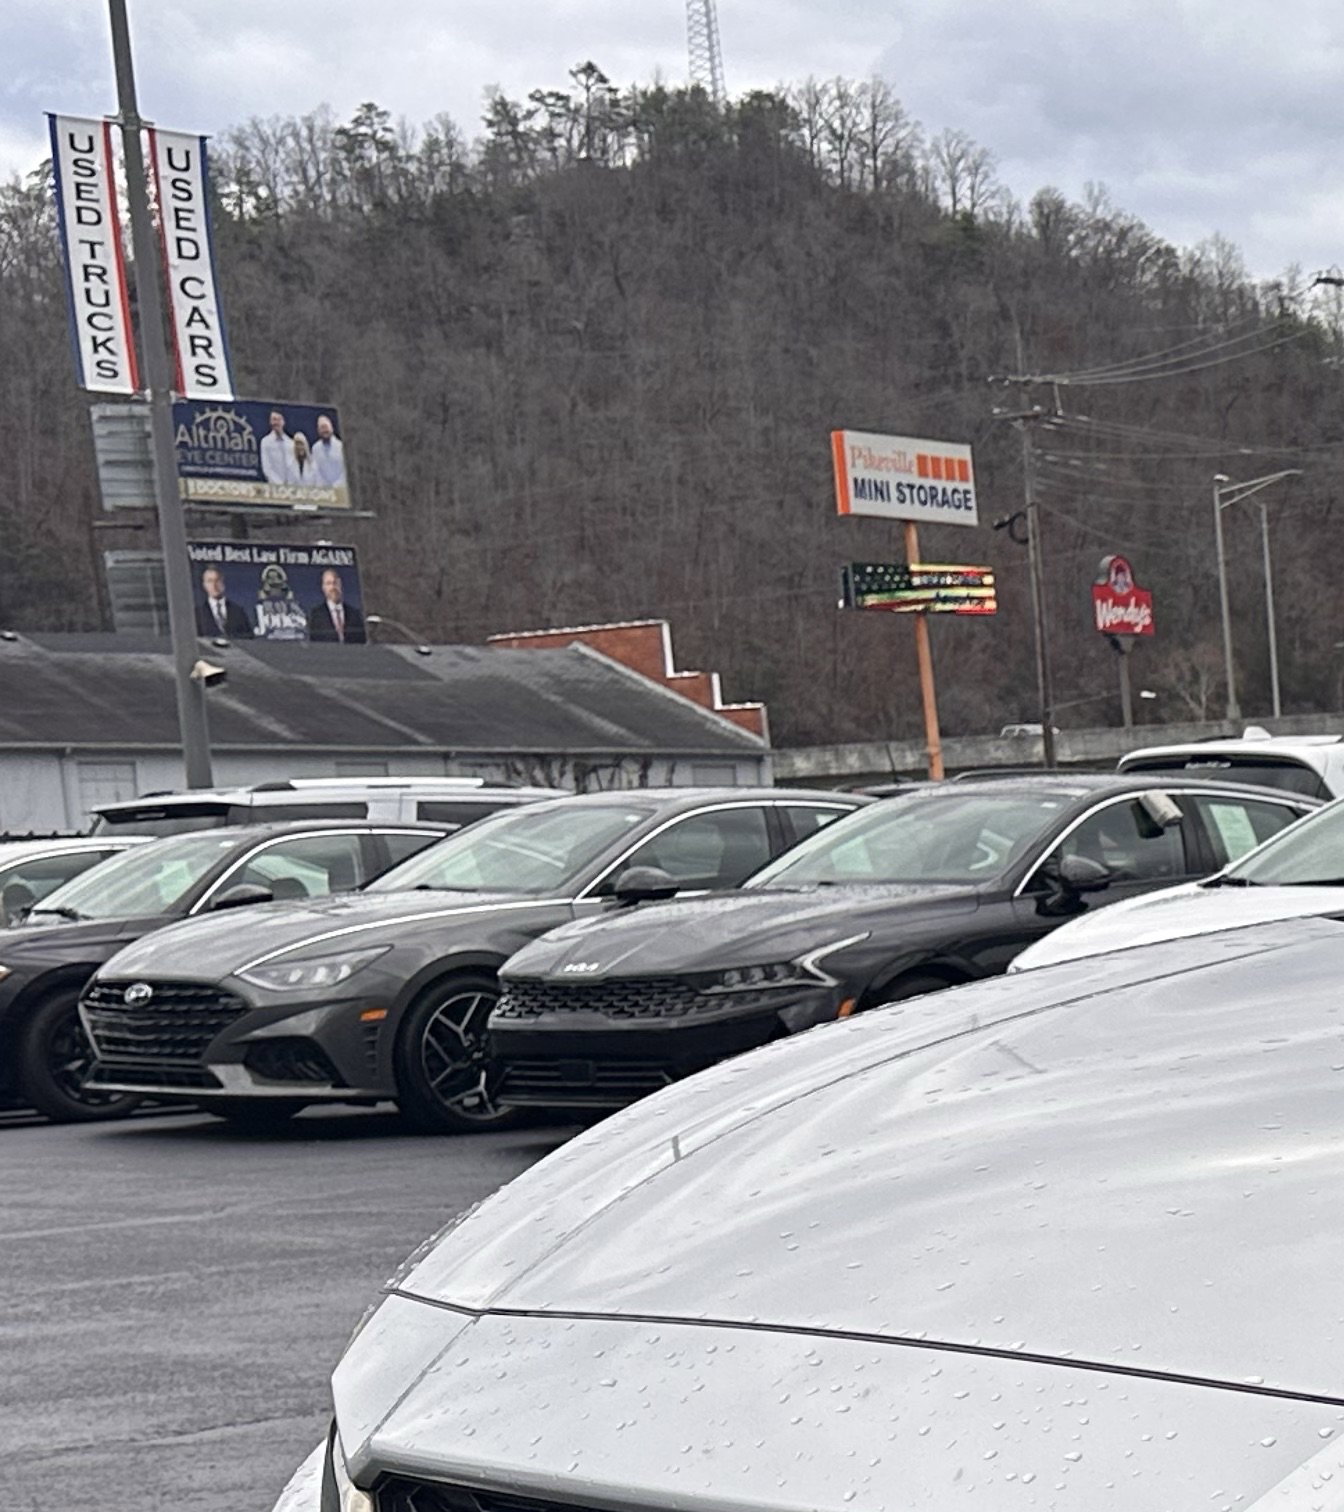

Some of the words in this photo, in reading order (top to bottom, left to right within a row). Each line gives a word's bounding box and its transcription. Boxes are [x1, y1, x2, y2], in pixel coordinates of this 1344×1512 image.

[69, 133, 102, 226] USED
[166, 147, 200, 260] USED
[79, 240, 119, 379] TRUCKS
[180, 277, 218, 387] CARS
[175, 424, 257, 452] Altman
[854, 477, 891, 502] MINI
[896, 481, 973, 511] STORAGE
